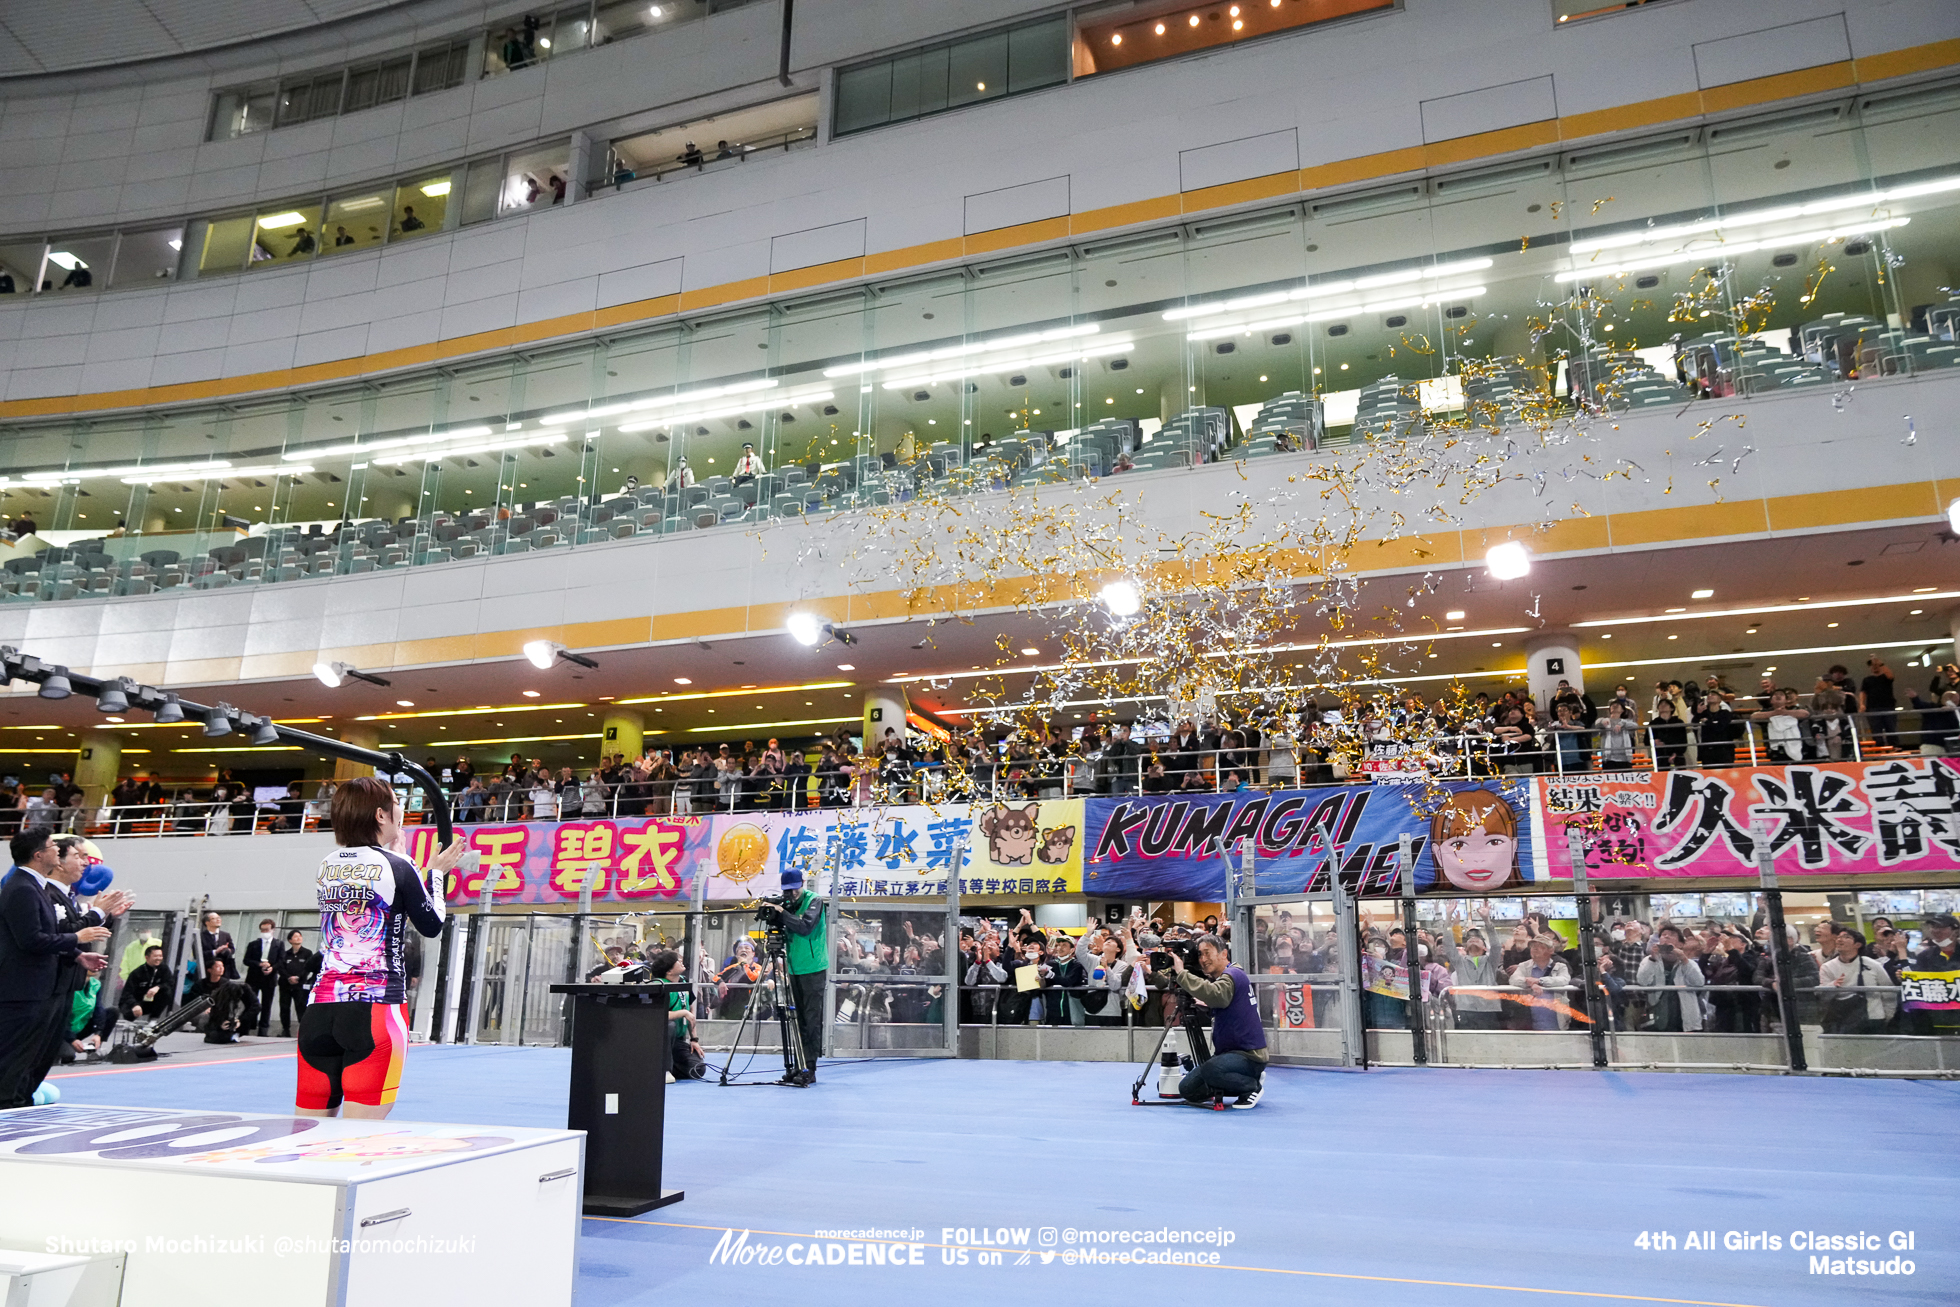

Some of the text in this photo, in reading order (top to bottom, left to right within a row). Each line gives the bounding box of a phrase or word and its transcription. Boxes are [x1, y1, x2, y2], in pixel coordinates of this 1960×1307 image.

[1551, 661, 1560, 671] 4
[1089, 790, 1373, 864] KUMAGAI
[776, 818, 973, 873] 佐藤水菜
[551, 821, 685, 897] 碧衣
[1304, 834, 1429, 897] MEI
[316, 860, 383, 886] Queen
[339, 884, 375, 900] Girls
[1110, 908, 1119, 920] 5
[1612, 899, 1623, 910] 4
[393, 913, 403, 934] CLUB
[711, 916, 719, 926] 6
